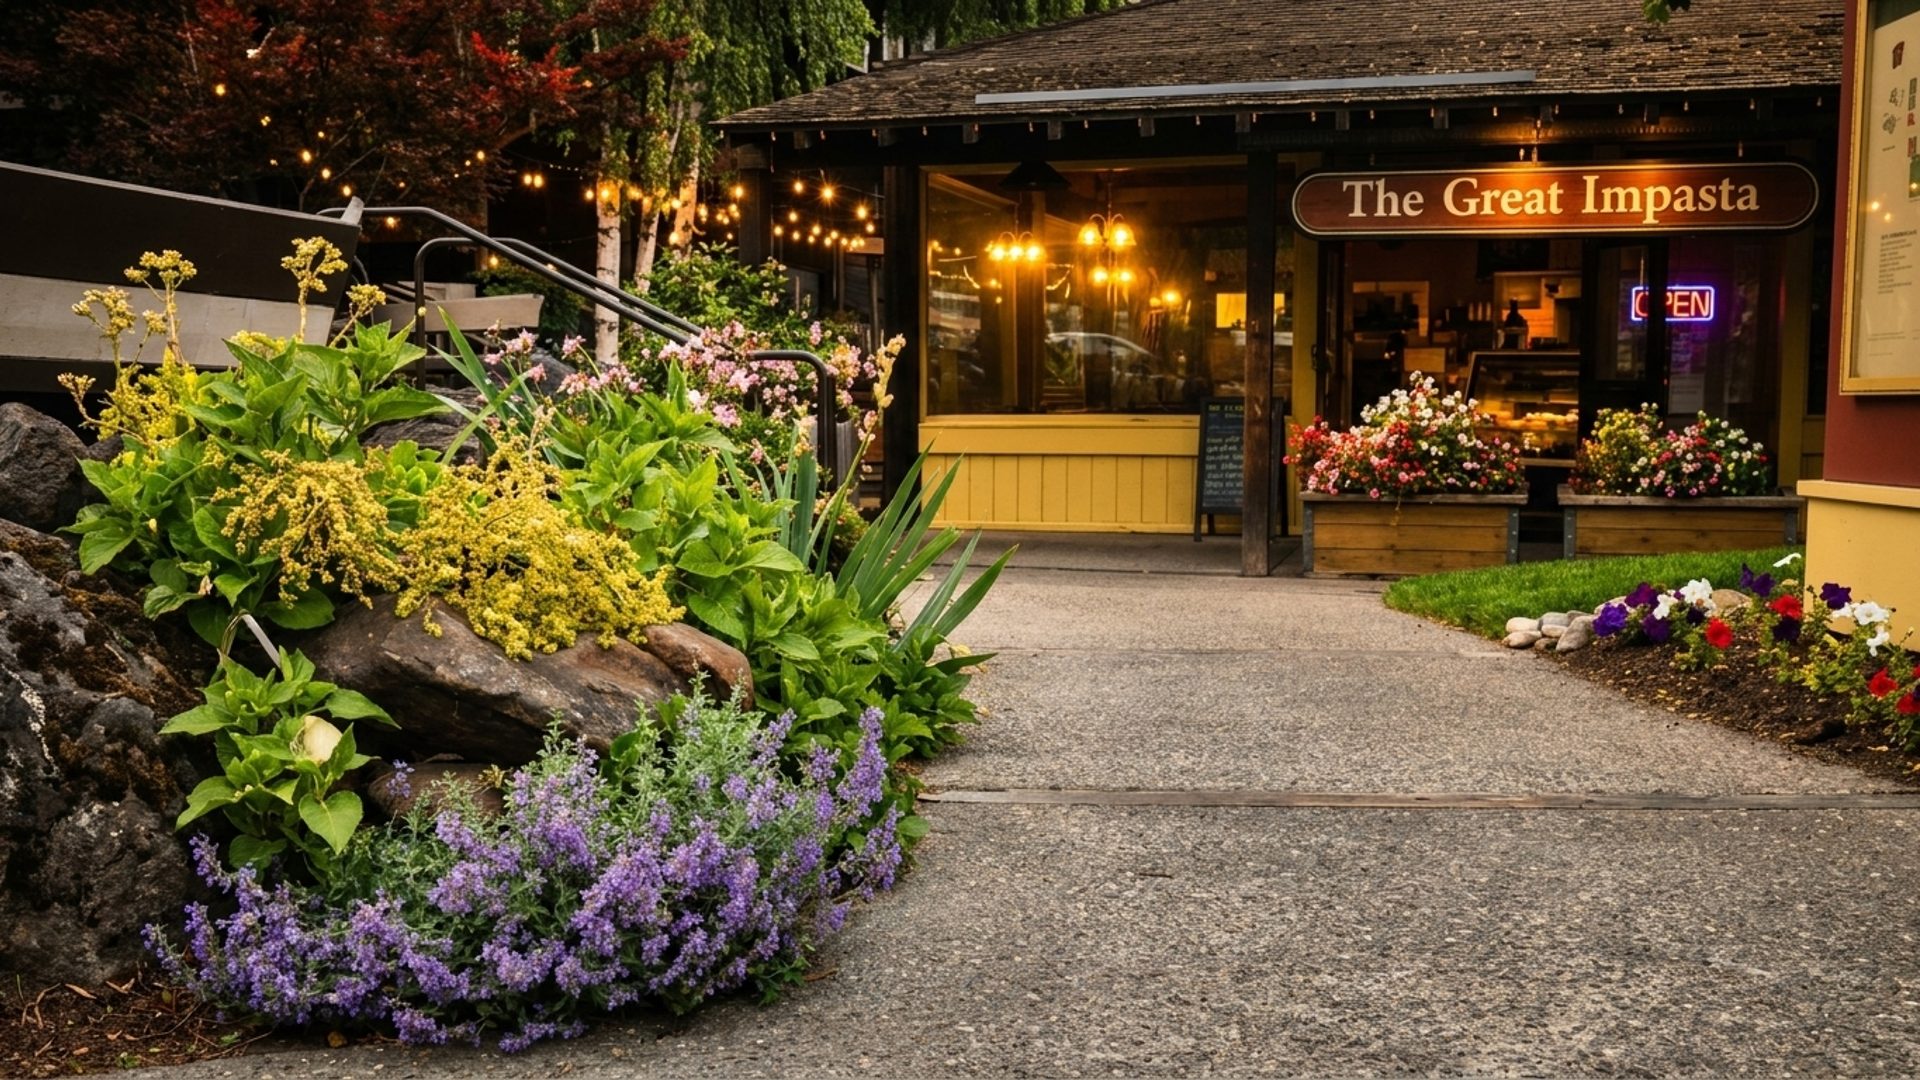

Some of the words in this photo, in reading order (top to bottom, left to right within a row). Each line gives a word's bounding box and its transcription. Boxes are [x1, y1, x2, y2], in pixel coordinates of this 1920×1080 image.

[1343, 178, 1424, 217] The
[1443, 177, 1564, 216] Great
[1582, 175, 1760, 224] Impasta
